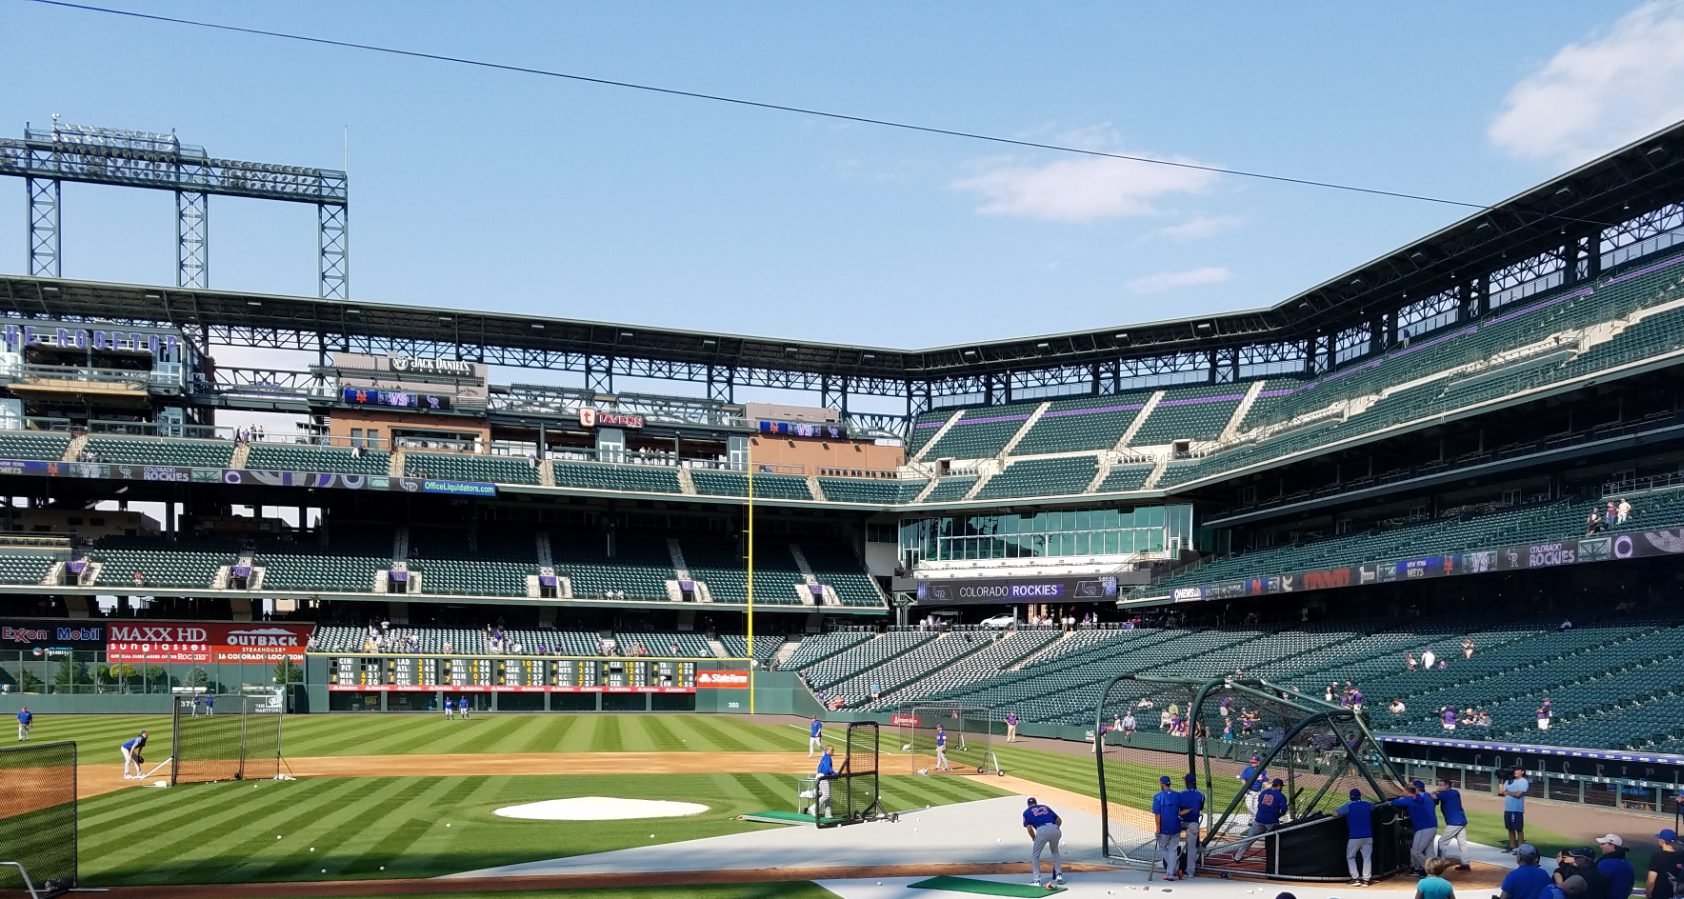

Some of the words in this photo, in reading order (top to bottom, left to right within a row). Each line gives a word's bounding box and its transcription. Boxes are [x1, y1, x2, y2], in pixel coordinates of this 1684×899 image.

[56, 328, 178, 356] ROOFTOP
[410, 356, 434, 369] JACK
[435, 358, 472, 372] DANIEL'S
[599, 412, 644, 426] TAVERN
[143, 472, 189, 484] ROCKIES
[424, 481, 494, 493] OfficeLiquidators.com
[1529, 543, 1562, 554] COLORADO
[1529, 550, 1575, 568] ROCKIES
[959, 586, 1010, 599] COLORADO
[1012, 586, 1058, 597] ROCKIES
[2, 626, 48, 643] Exxon
[57, 627, 100, 641] Mobil
[111, 627, 173, 641] MAXX
[176, 627, 207, 642] HD
[227, 635, 298, 647] OUTBACK
[110, 643, 206, 652] sunglasses
